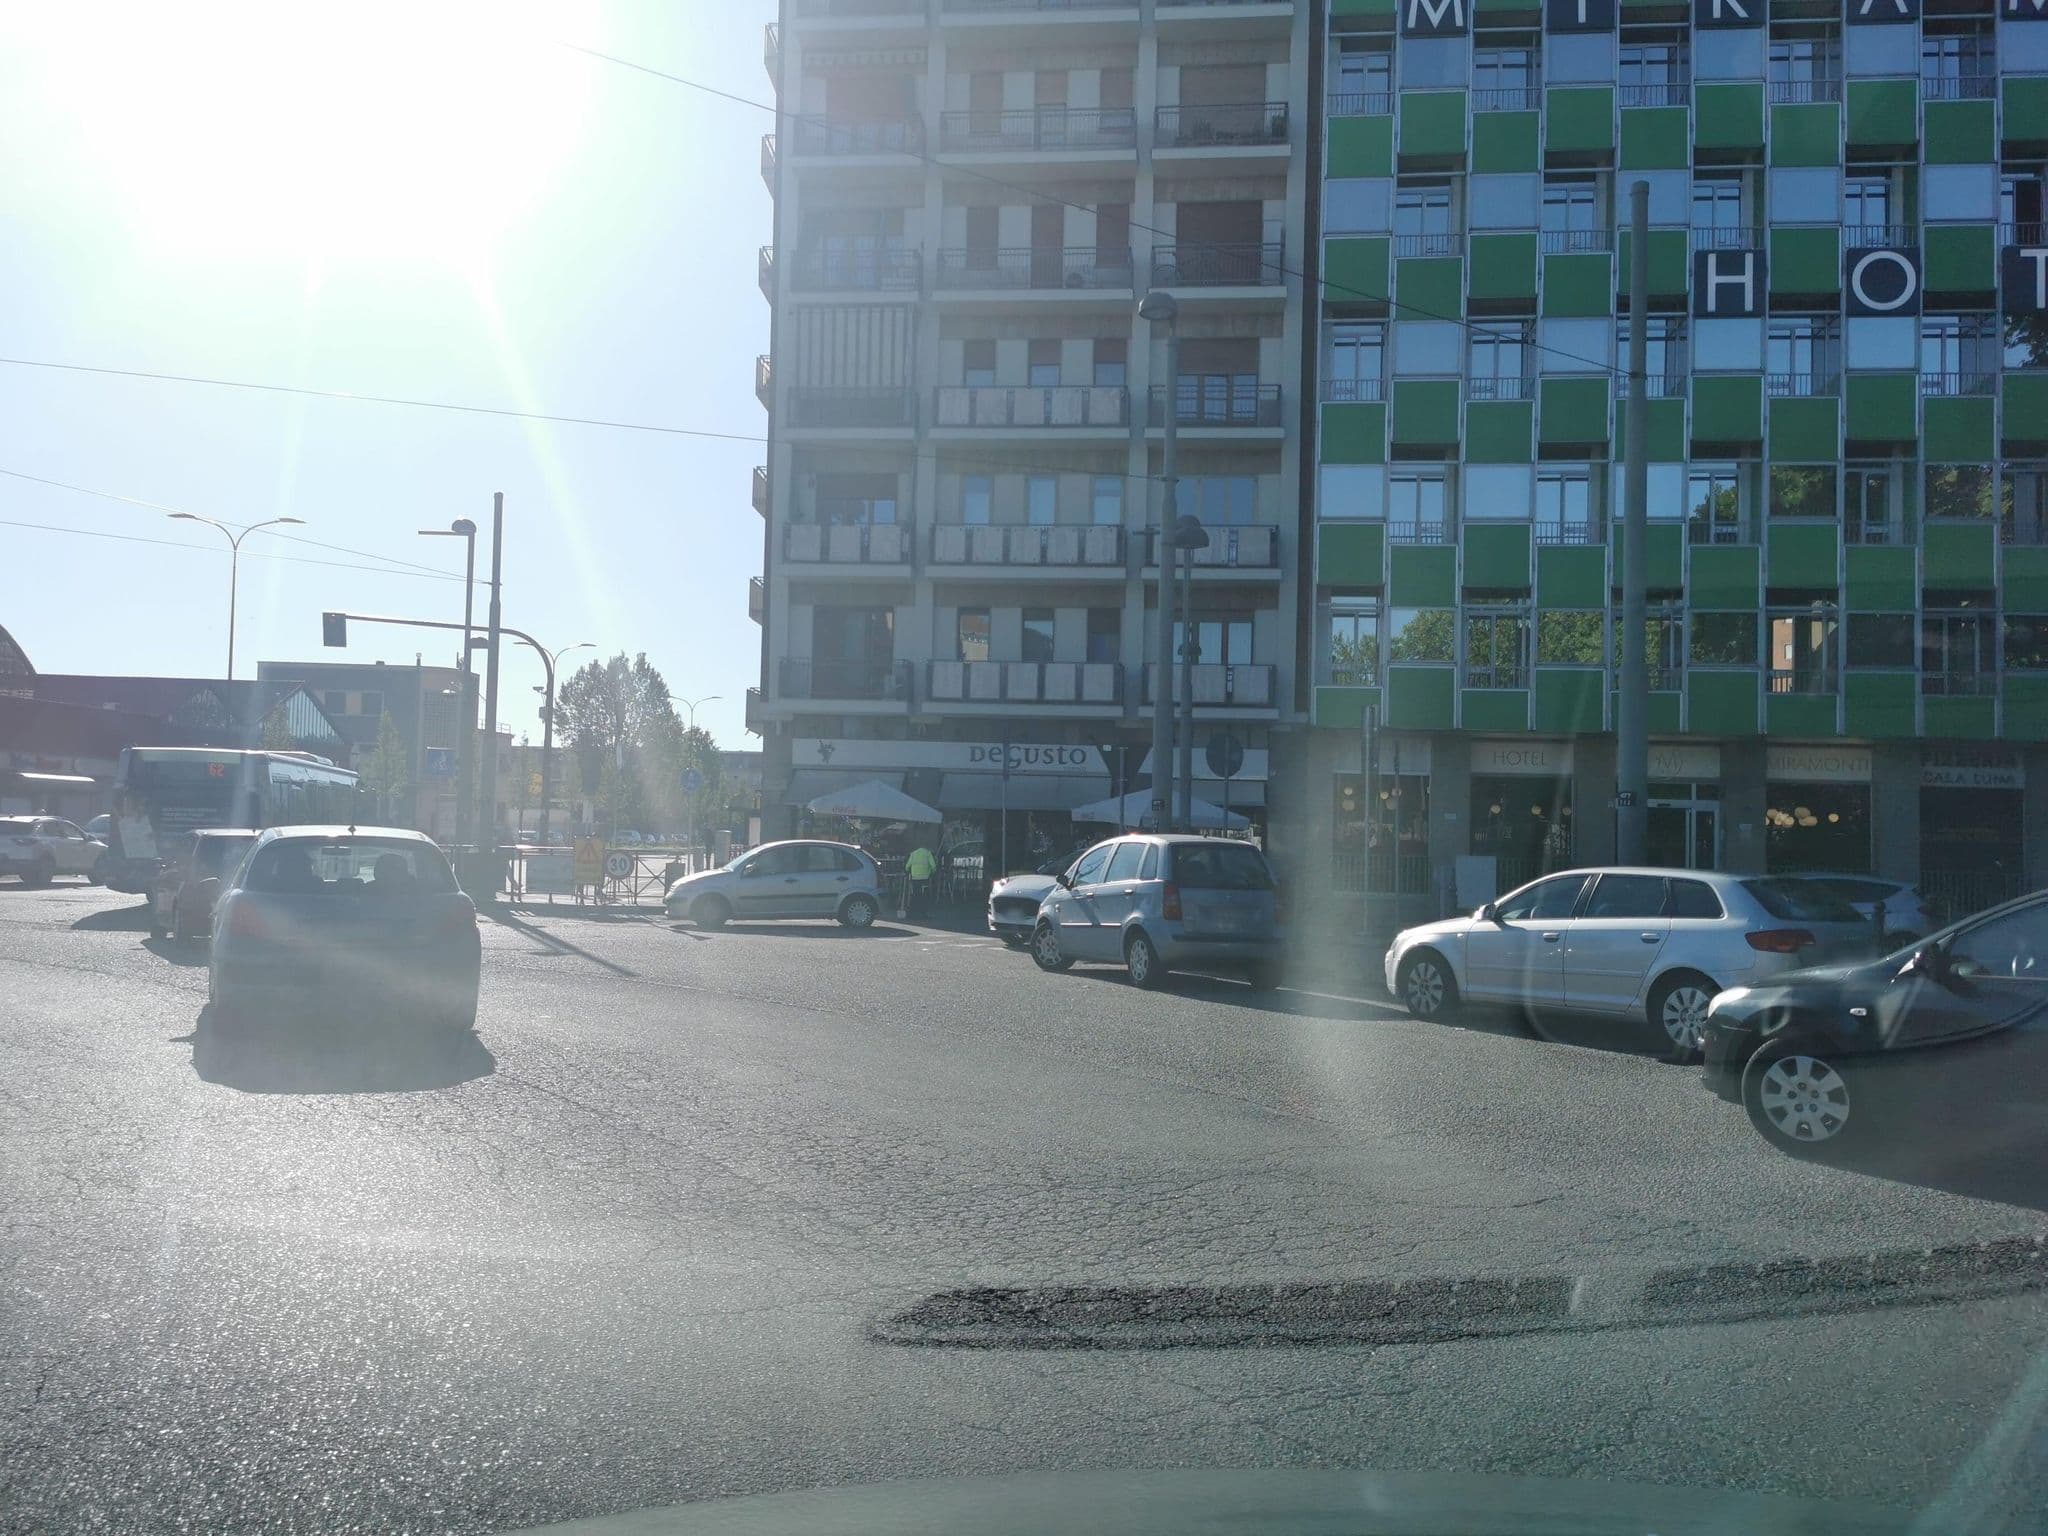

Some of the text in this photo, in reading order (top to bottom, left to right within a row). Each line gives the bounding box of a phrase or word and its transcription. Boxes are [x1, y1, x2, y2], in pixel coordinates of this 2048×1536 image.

[1493, 751, 1547, 766] HOTEL
[208, 762, 225, 777] 62
[610, 857, 628, 870] 30
